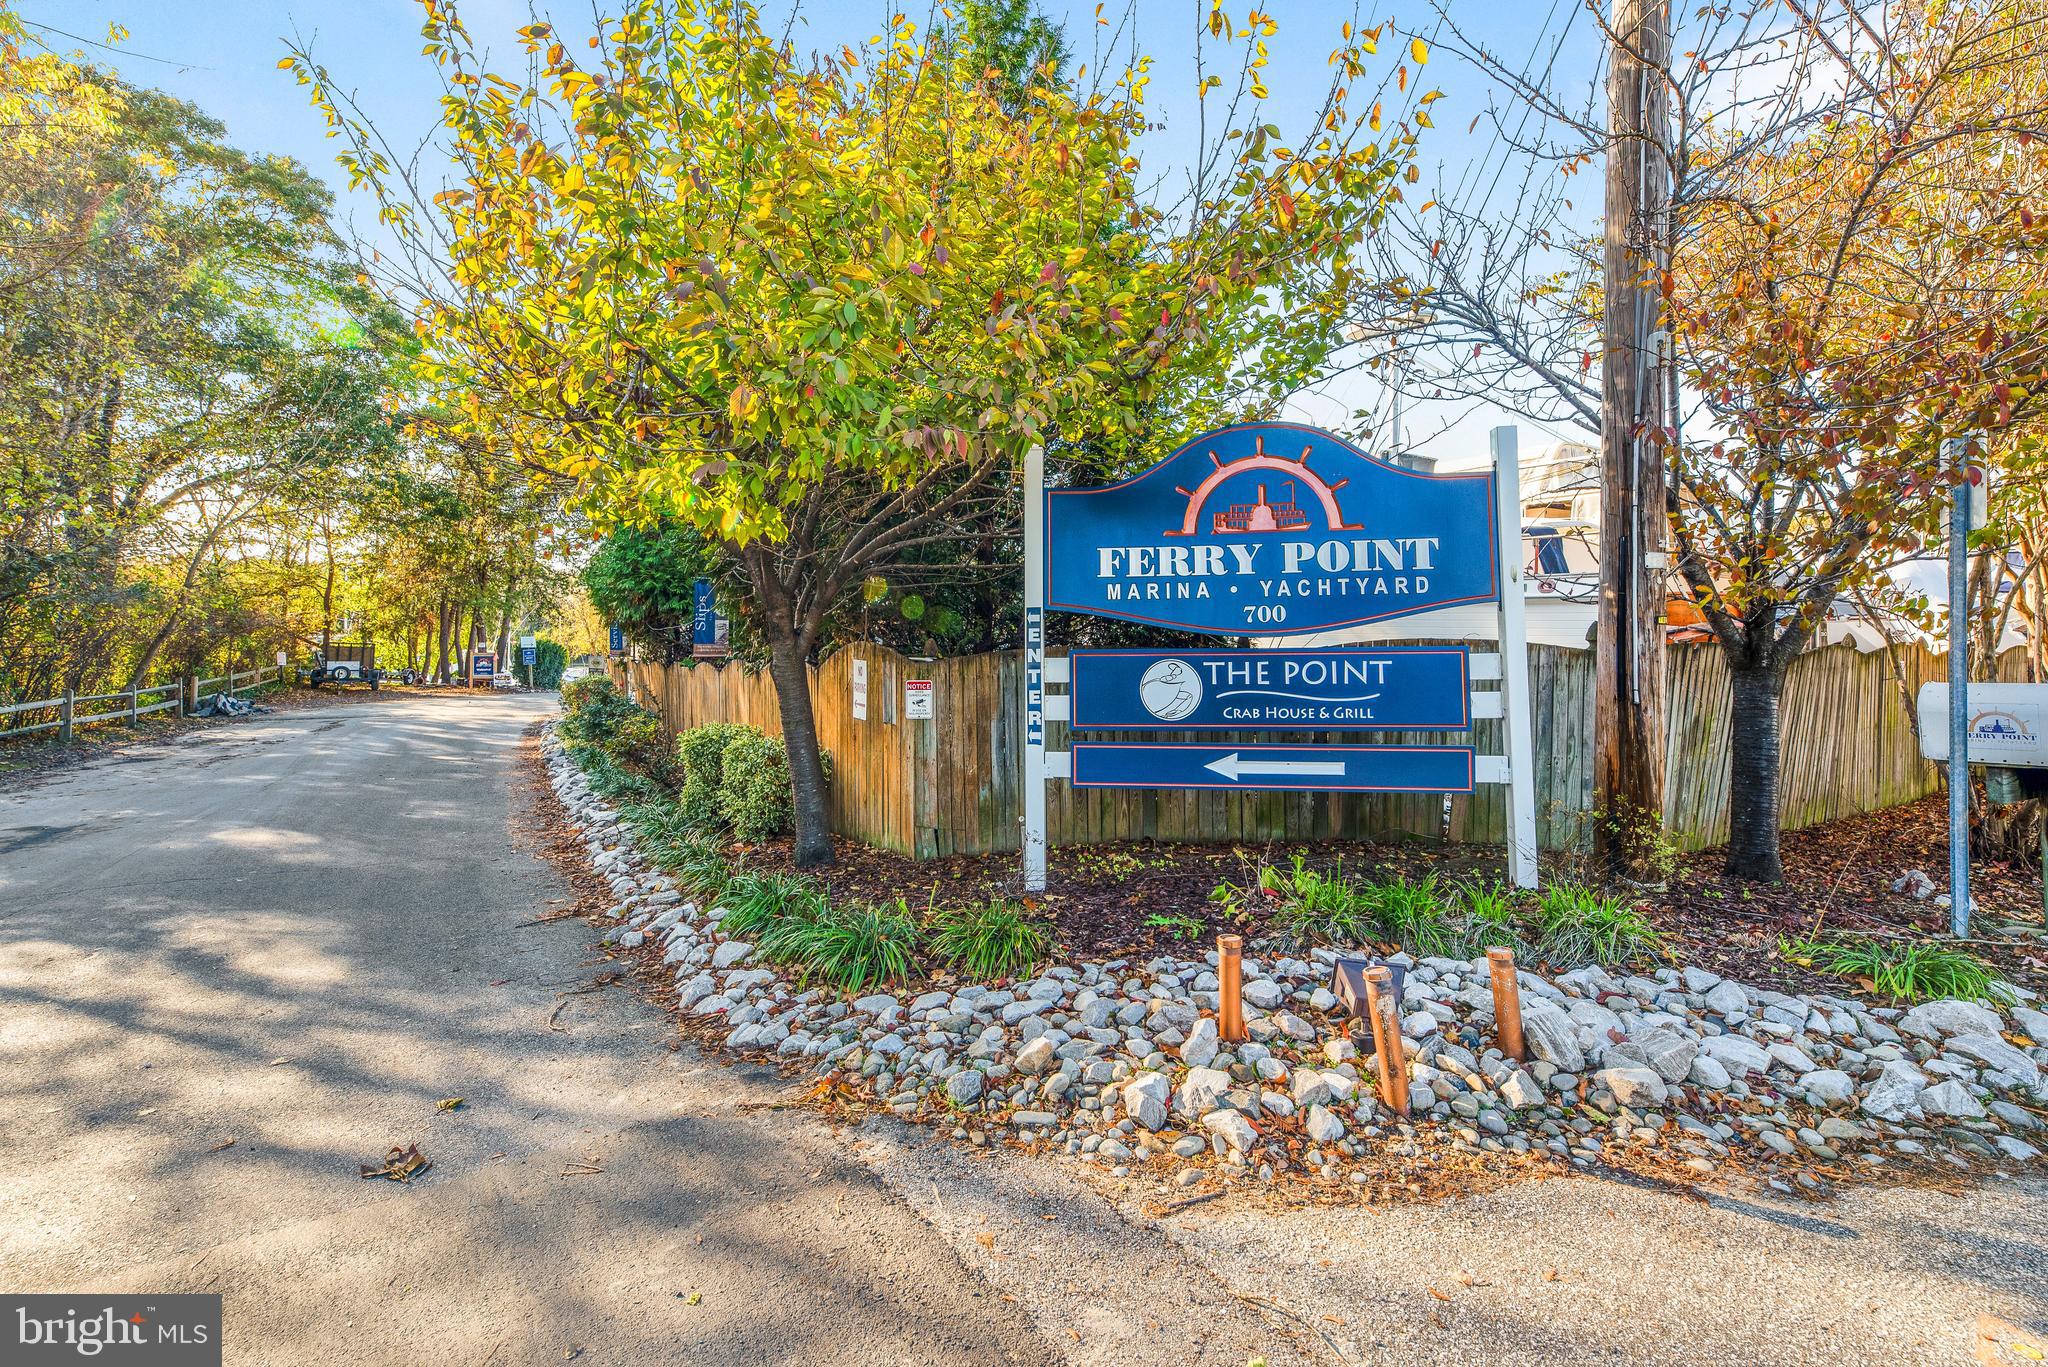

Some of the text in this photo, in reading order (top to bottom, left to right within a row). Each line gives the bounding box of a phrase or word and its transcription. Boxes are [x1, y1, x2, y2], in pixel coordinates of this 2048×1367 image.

[1096, 537, 1440, 578] FERRY POINT
[1107, 576, 1429, 600] MARINA YACHTYARD
[695, 595, 709, 631] Slips
[1243, 604, 1287, 623] 700
[1027, 627, 1042, 726] ENTER
[1203, 660, 1393, 685] THE POINT
[1223, 706, 1375, 719] CRAB HOUSE & GRILL
